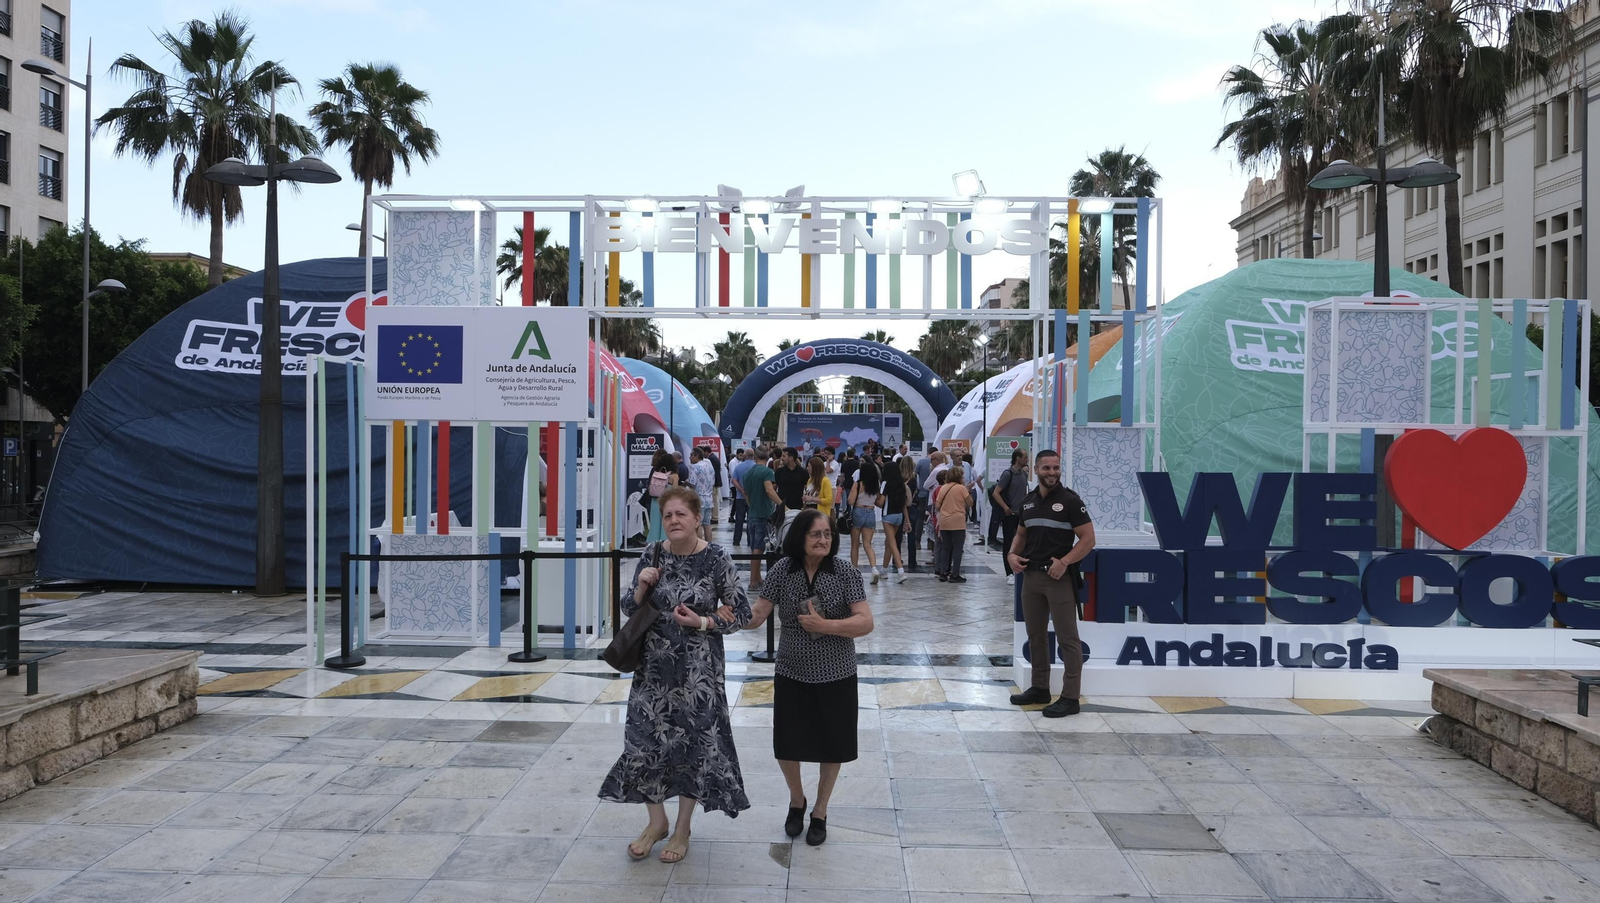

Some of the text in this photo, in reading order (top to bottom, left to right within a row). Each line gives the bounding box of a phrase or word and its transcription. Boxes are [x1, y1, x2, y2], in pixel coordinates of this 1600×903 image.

[594, 217, 1047, 255] BIENVENIDOS
[188, 325, 366, 357] FRESC
[182, 354, 209, 366] de
[486, 363, 577, 373] Junta de Andalucía
[766, 345, 893, 374] WE FRESCOS
[1237, 354, 1262, 366] de
[377, 385, 441, 394] UNIÓN EUROPEA
[1136, 472, 1378, 550] WE
[1116, 633, 1399, 671] Andalucía
